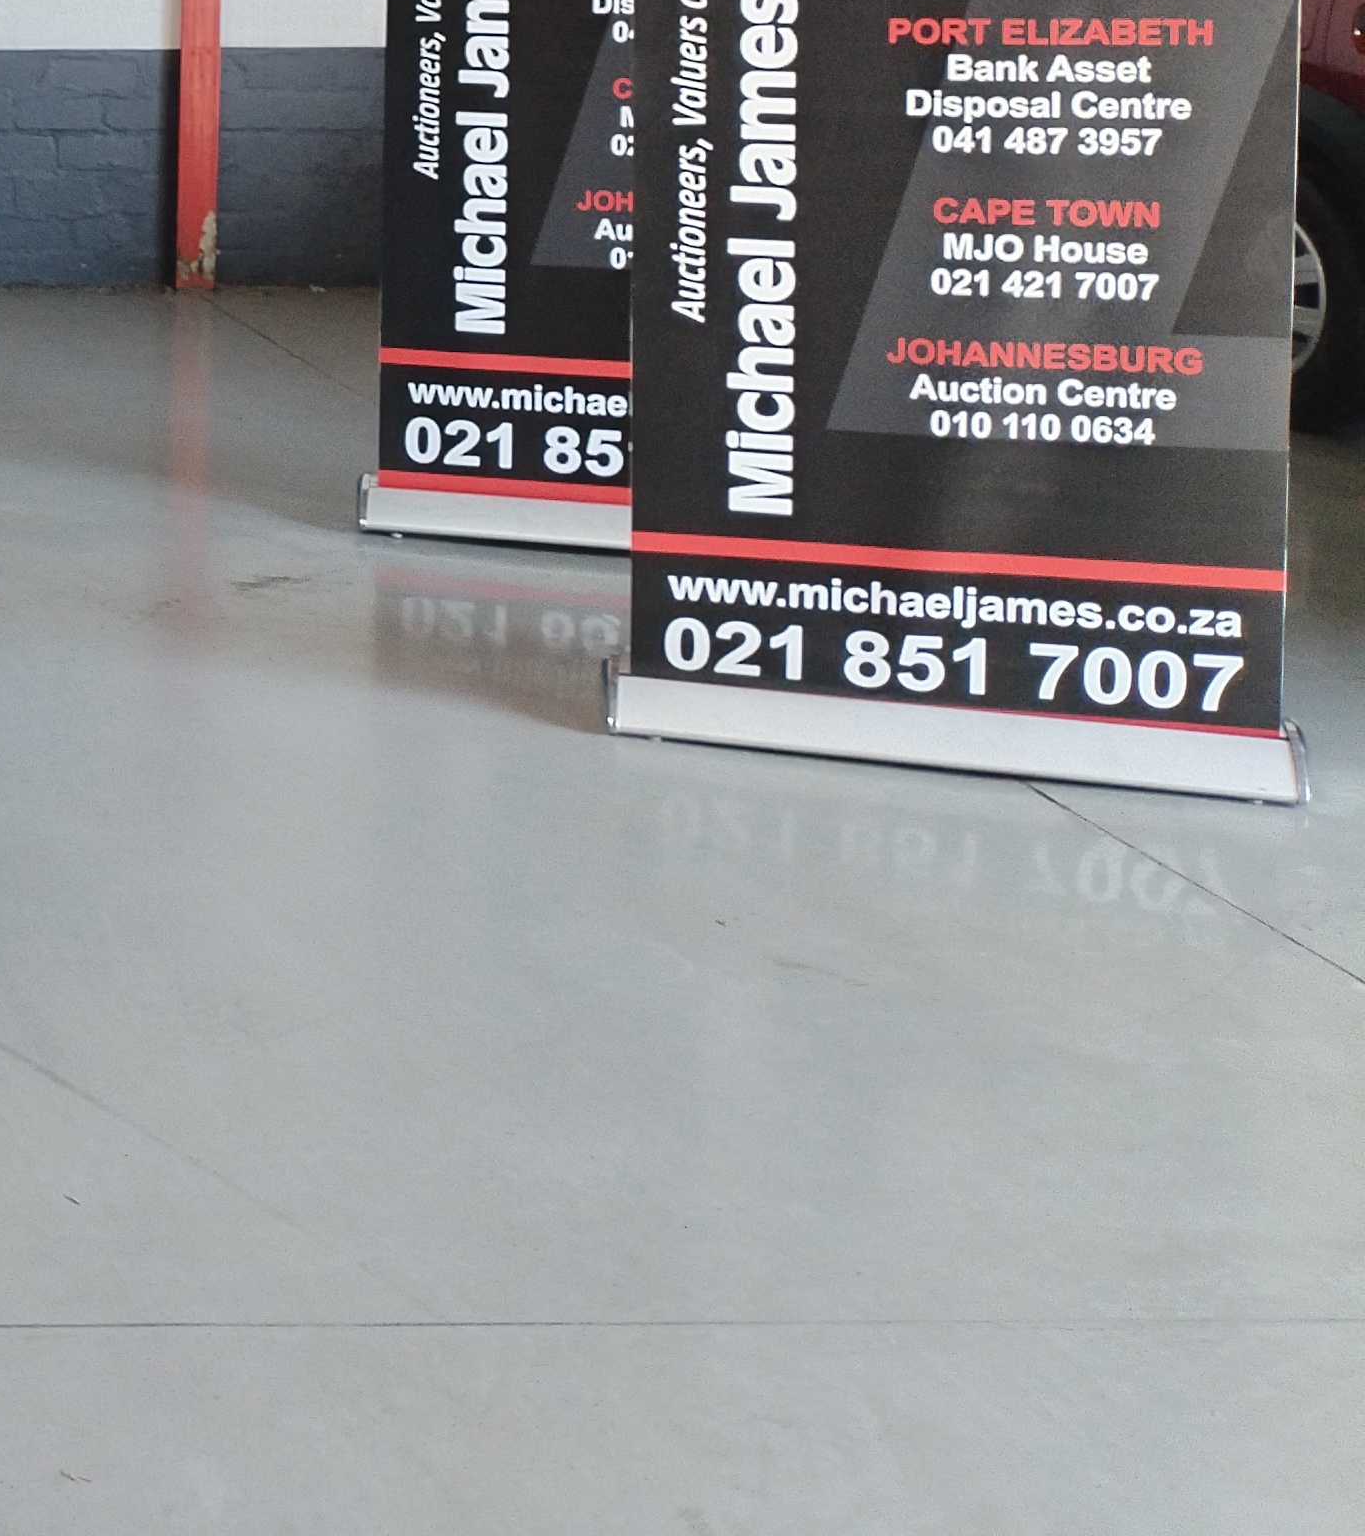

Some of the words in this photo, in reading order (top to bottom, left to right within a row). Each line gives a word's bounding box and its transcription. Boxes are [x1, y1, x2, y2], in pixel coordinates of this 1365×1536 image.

[889, 18, 991, 45] PORT
[1002, 18, 1213, 46] ELIZABETH
[671, 16, 707, 125] Valuers
[948, 54, 1039, 82] Bank
[1046, 55, 1151, 83] Asset
[412, 32, 446, 179] Auctioneers,
[906, 90, 1061, 123] Disposal
[1071, 91, 1192, 120] Centre
[932, 126, 991, 153] 041
[1004, 127, 1068, 154] 487
[1078, 128, 1162, 155] 3957
[454, 112, 508, 334] Michael
[670, 139, 713, 323] Auctioneers,
[934, 198, 1036, 225] CAPE
[1046, 200, 1160, 228] TOWN
[944, 233, 1024, 262] MJO
[1034, 235, 1148, 264] House
[931, 268, 989, 296] 021
[1002, 270, 1061, 298] 421
[1075, 272, 1159, 301] 7007
[887, 338, 1203, 375] JOHANNESBURG
[726, 238, 796, 515] Michael
[910, 374, 1046, 405] Auction
[1057, 379, 1176, 410] Centre
[930, 410, 992, 438] 010
[1003, 412, 1061, 441] 110
[1071, 415, 1155, 445] 0634
[405, 417, 512, 469] 021
[544, 426, 623, 476] 85
[666, 573, 1245, 639] www.michaeljames.co.za
[665, 618, 802, 680] 021
[844, 631, 986, 695] 851
[1030, 643, 1244, 711] 7007
